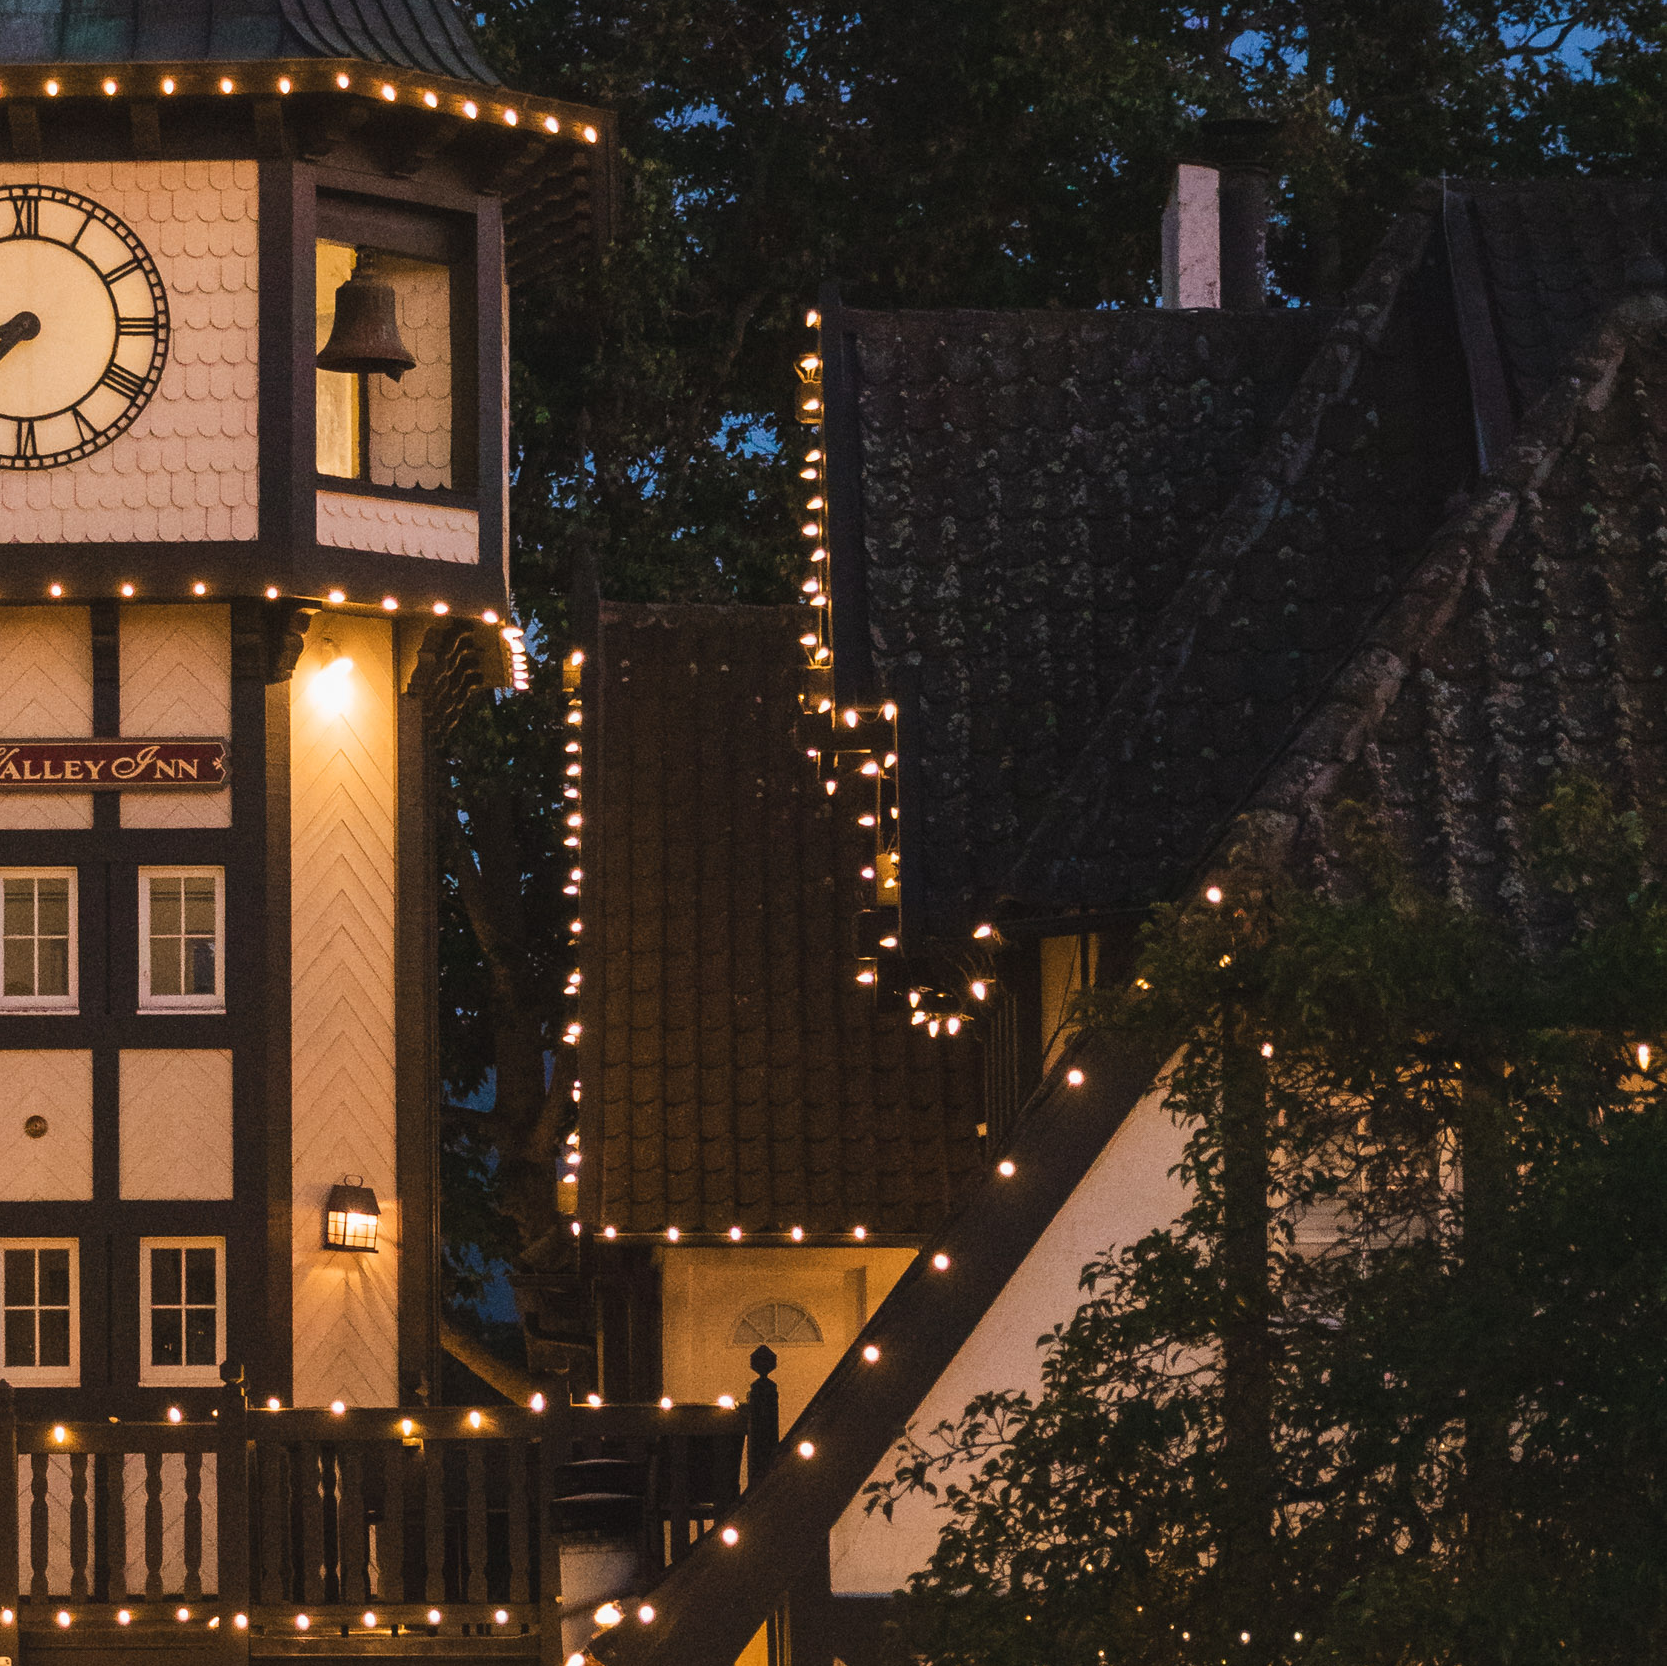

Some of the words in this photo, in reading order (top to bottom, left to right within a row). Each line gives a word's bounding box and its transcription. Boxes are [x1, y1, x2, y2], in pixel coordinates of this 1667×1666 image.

[11, 197, 40, 238] XII
[103, 257, 142, 286] II
[117, 317, 157, 336] III
[15, 419, 39, 459] VI
[111, 745, 199, 780] INN
